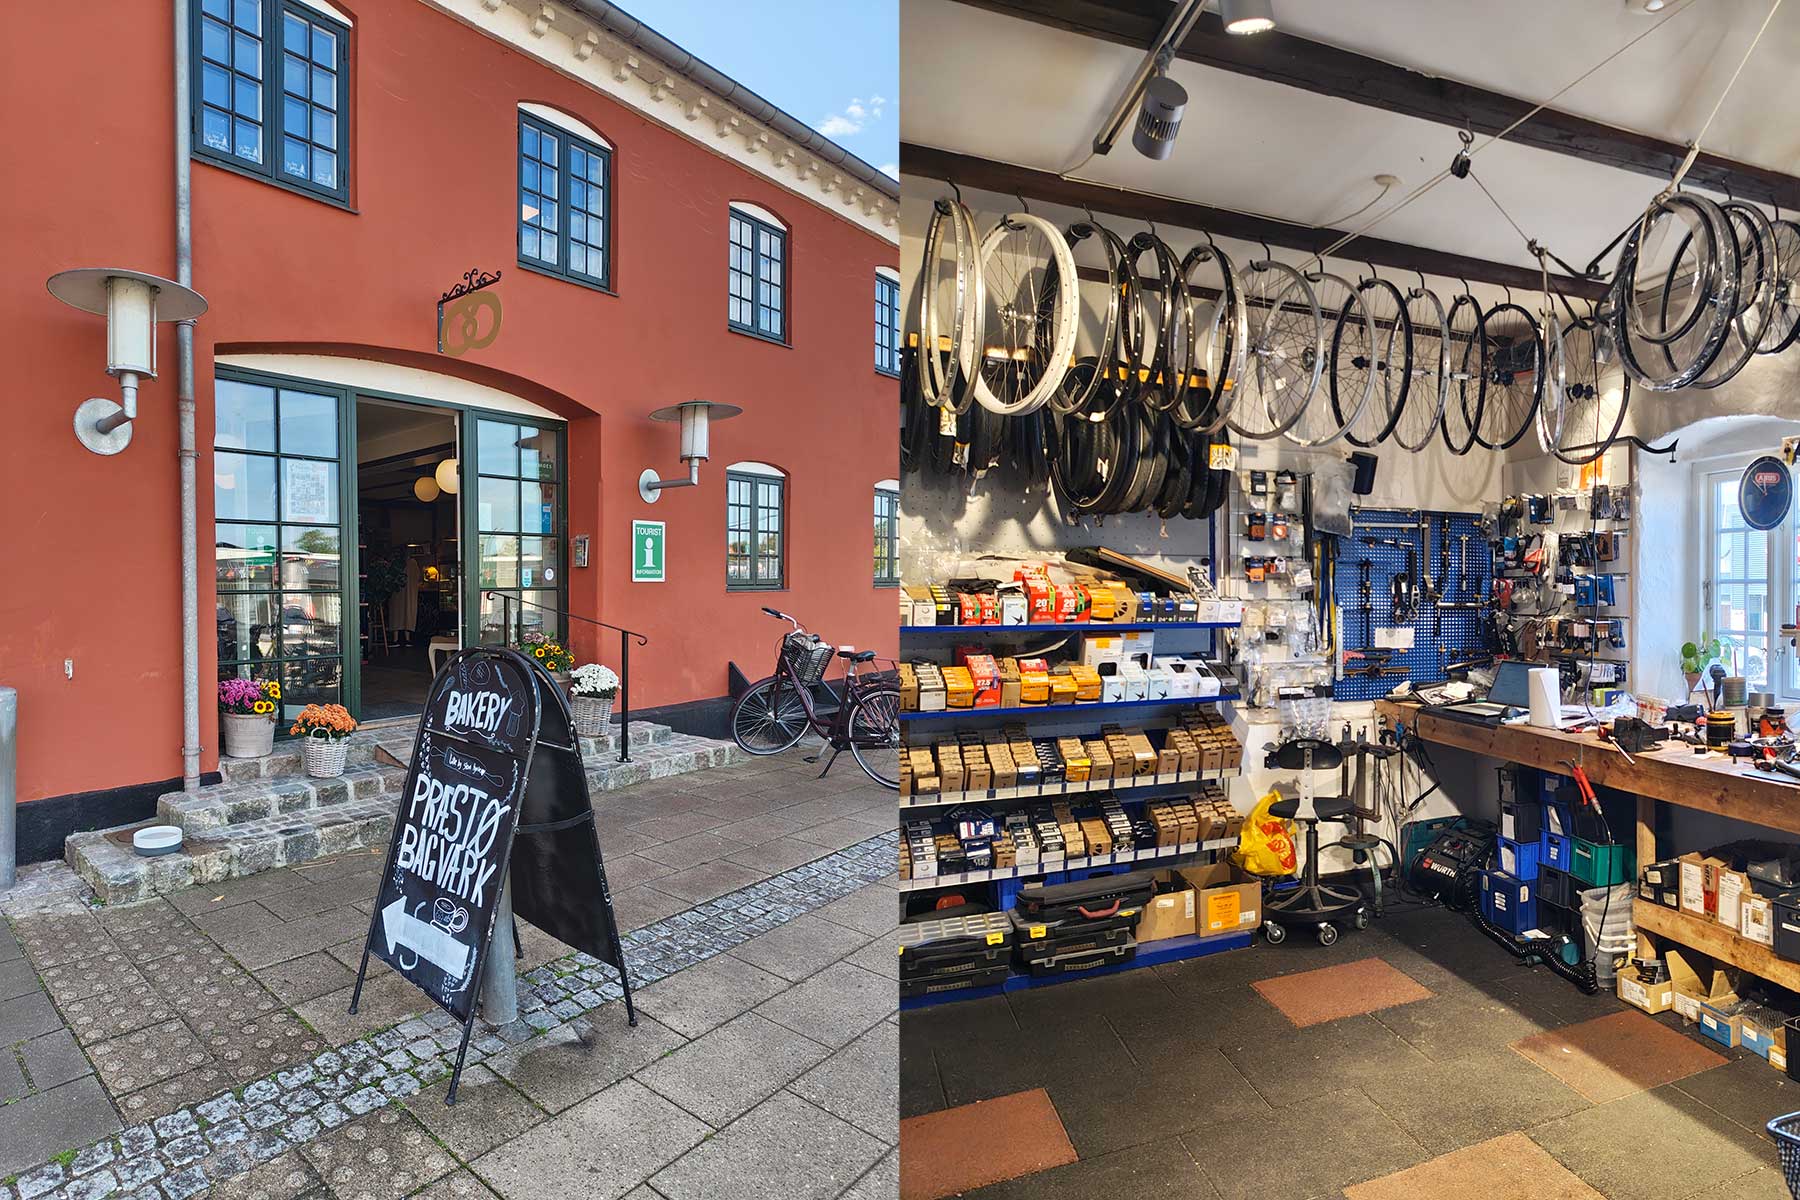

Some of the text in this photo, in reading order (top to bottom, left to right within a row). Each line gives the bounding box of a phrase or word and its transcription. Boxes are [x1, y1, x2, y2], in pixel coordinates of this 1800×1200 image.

[636, 527, 662, 536] TOURIST
[444, 690, 512, 732] BAKERY
[409, 773, 511, 859] PRÆSTØ
[397, 823, 497, 908] BAGVÆRK
